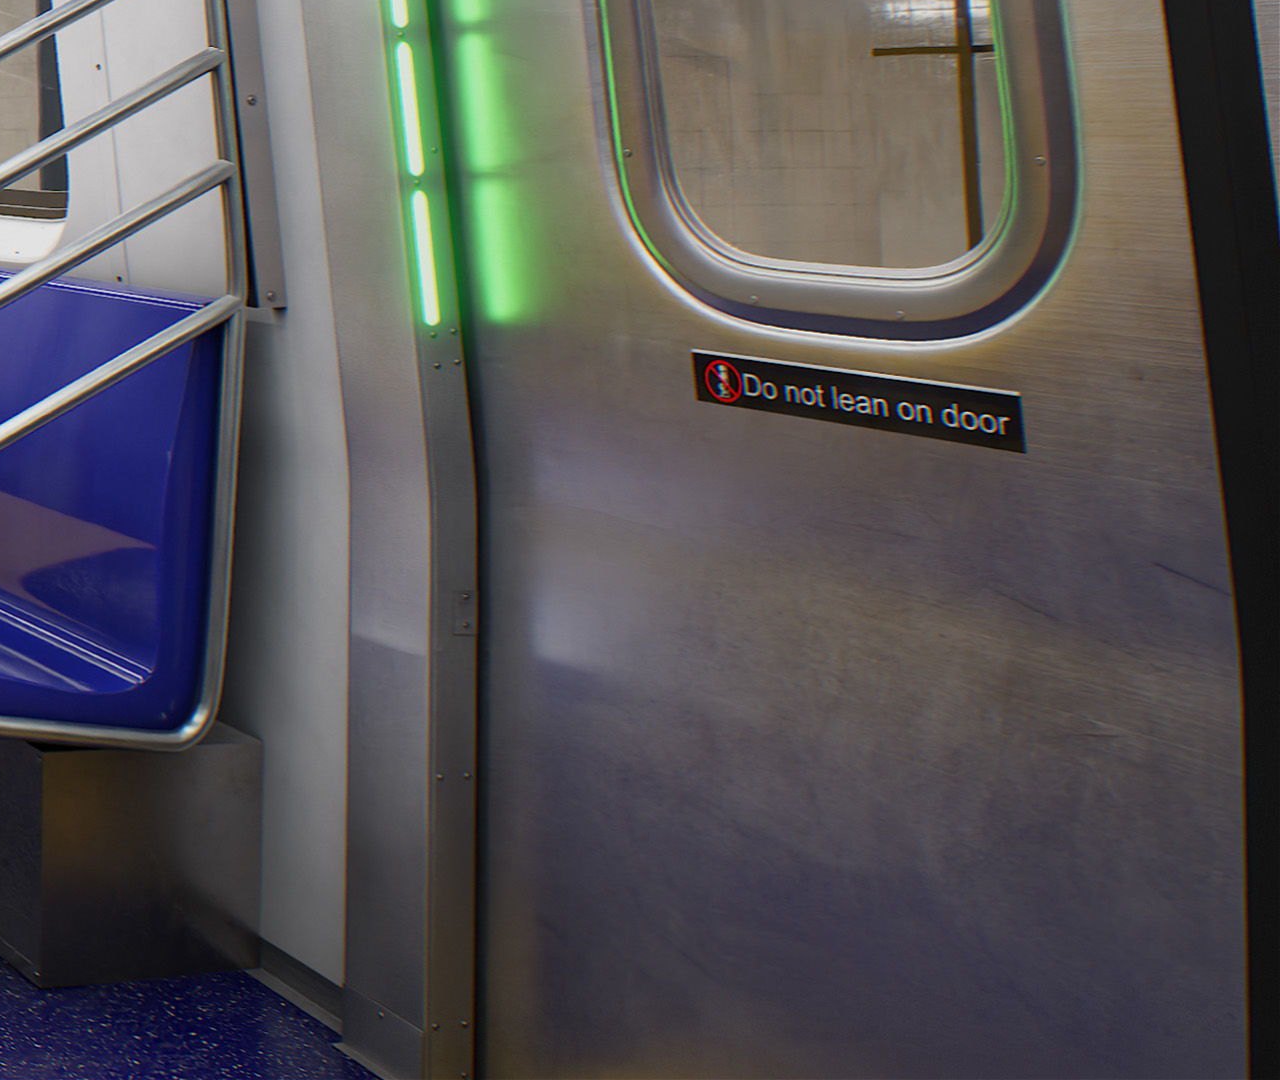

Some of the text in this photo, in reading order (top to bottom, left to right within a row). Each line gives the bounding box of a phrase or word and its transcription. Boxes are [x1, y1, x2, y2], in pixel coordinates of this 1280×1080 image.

[741, 373, 1011, 436] Do not lean on door
